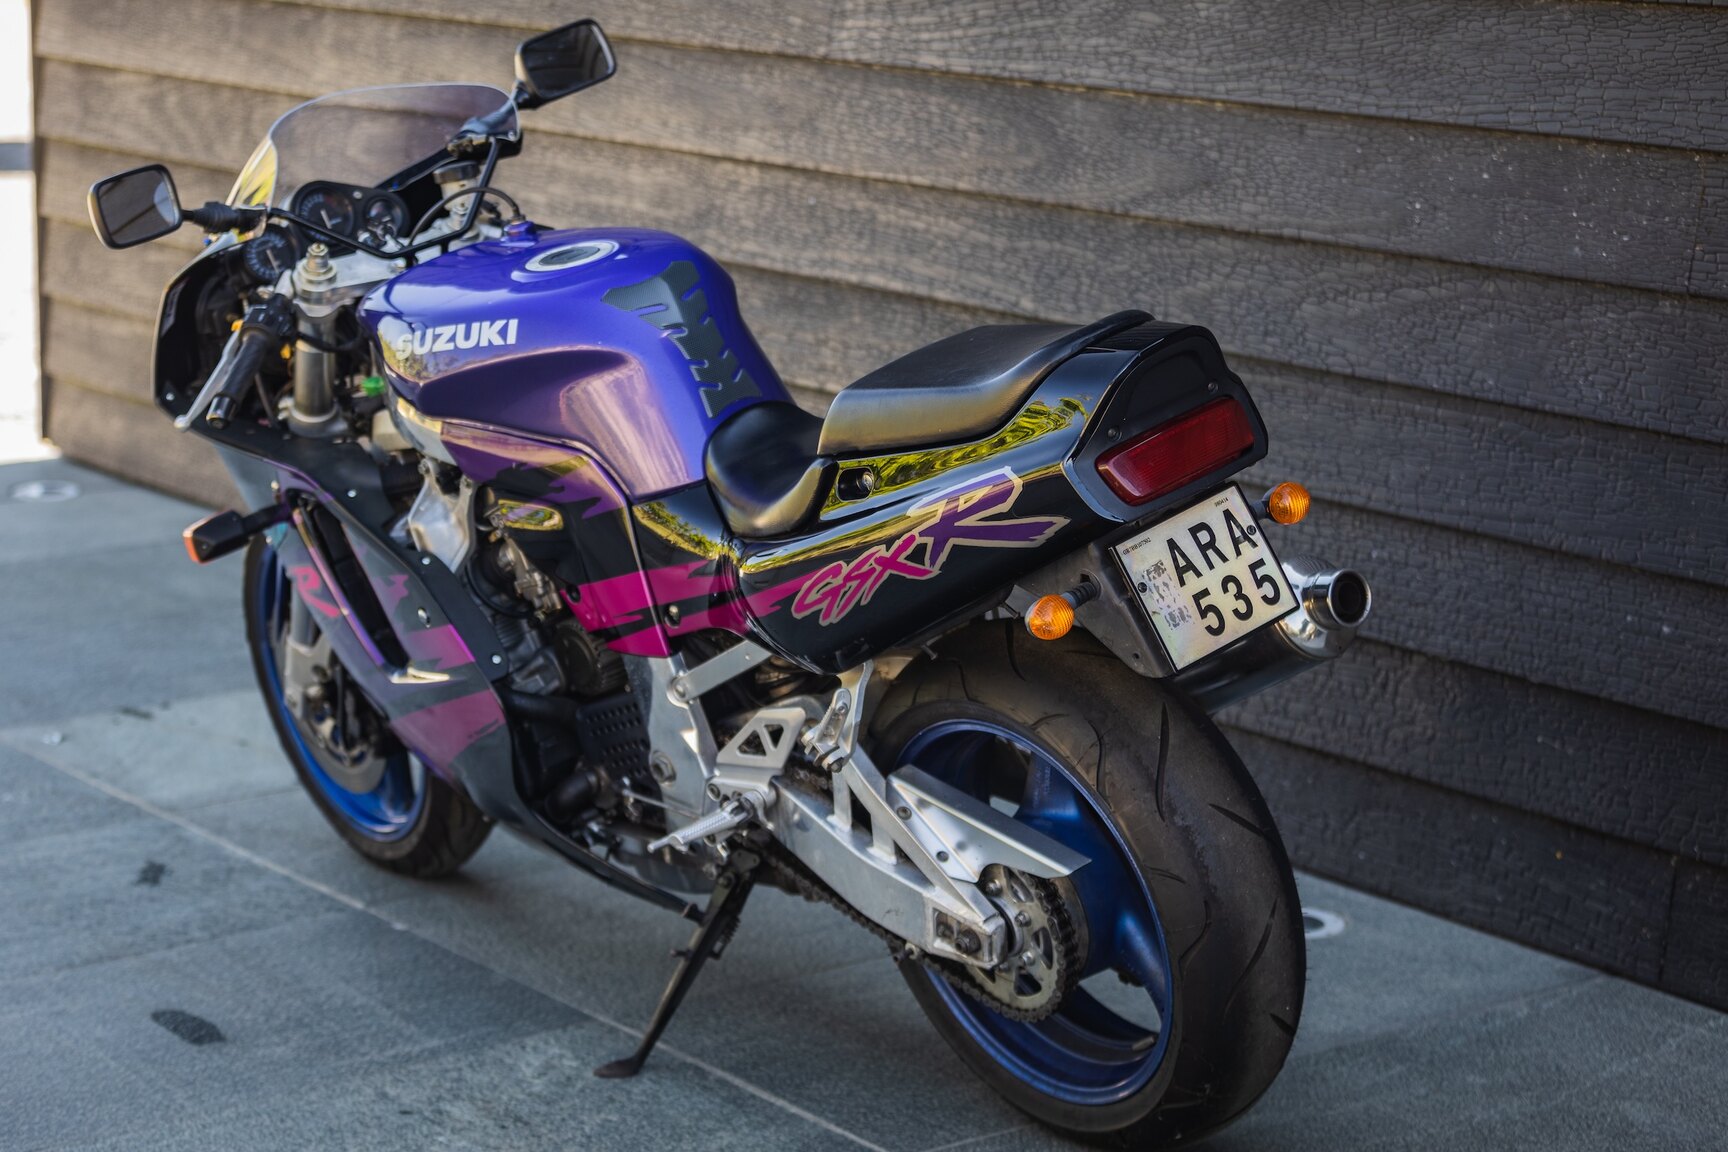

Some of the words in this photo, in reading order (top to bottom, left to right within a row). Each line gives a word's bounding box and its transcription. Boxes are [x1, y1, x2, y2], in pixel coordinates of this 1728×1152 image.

[396, 318, 519, 360] SUZUKI
[1166, 508, 1258, 588] ARA
[1192, 558, 1281, 637] 535
